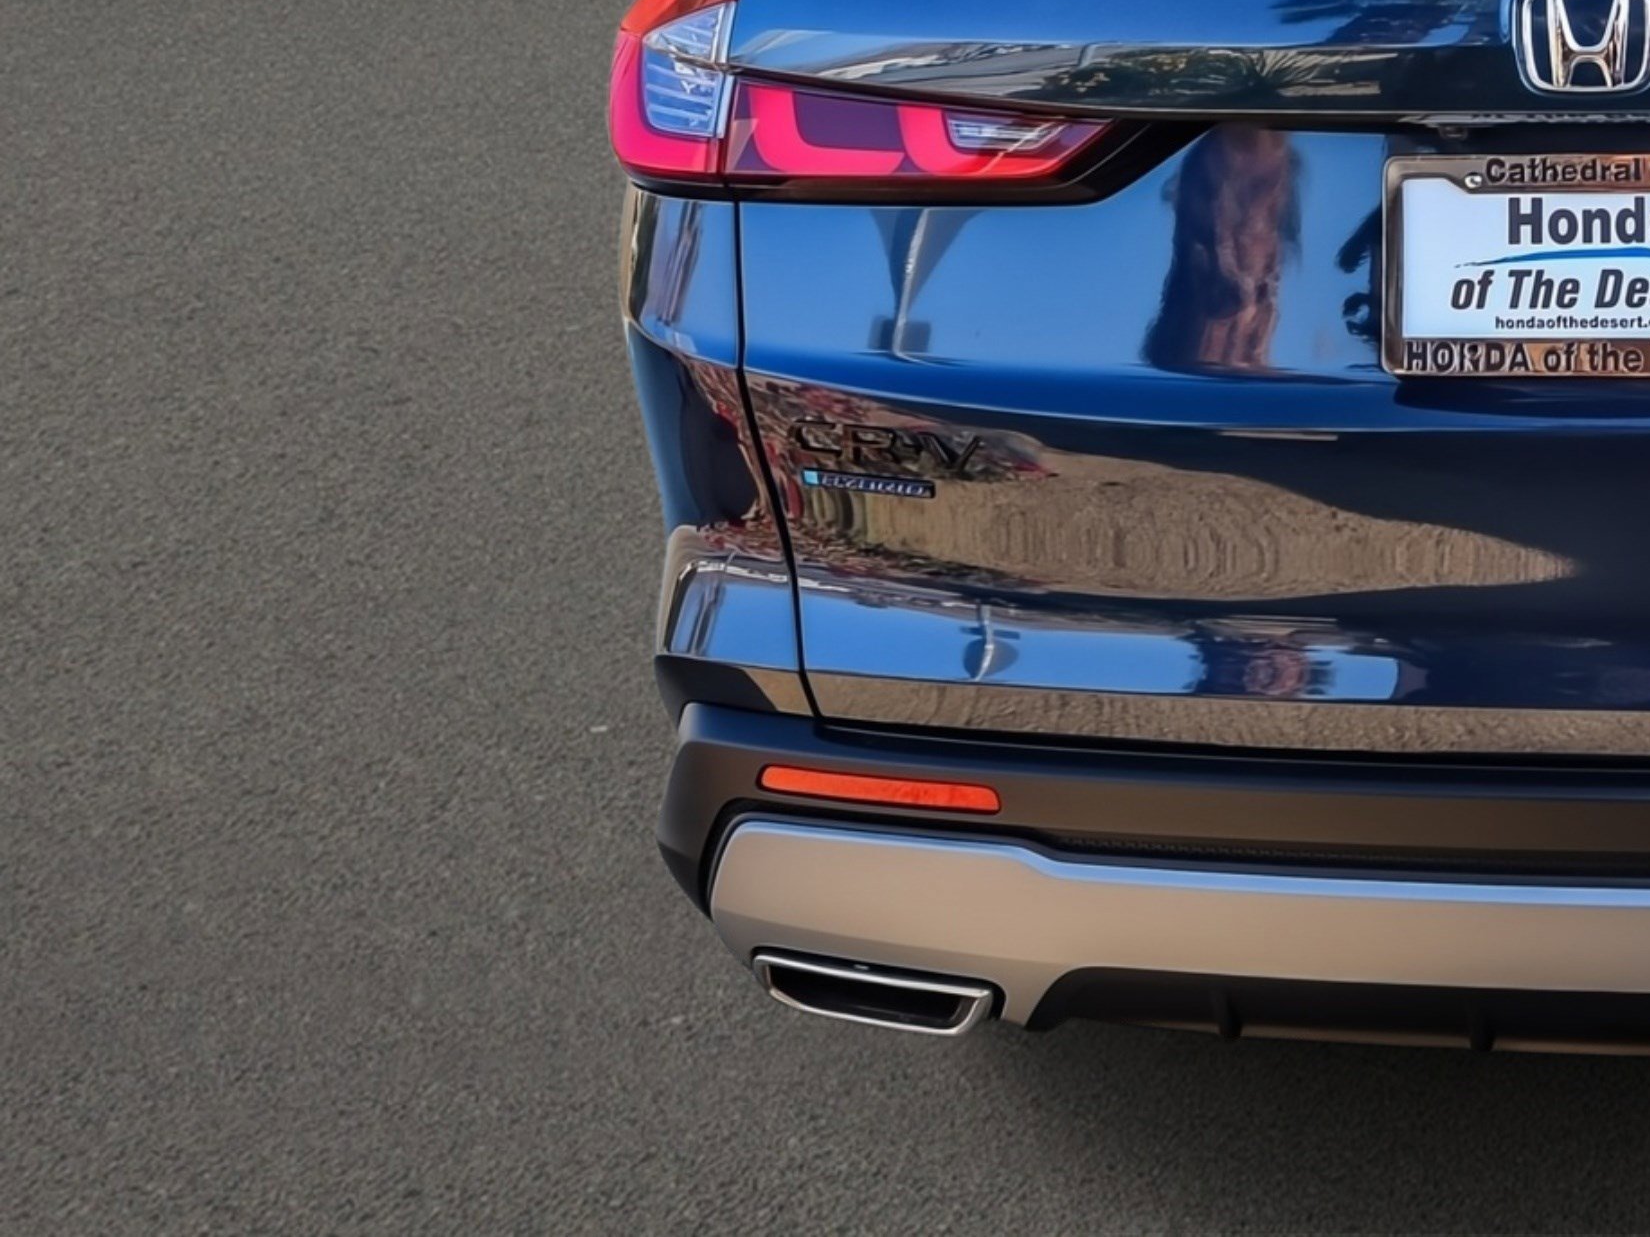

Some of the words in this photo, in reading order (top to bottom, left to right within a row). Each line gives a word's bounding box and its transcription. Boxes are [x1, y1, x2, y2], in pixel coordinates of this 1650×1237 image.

[1485, 157, 1642, 186] Cathedral
[1450, 268, 1495, 311] of
[1507, 268, 1581, 311] The
[1405, 340, 1532, 373] HONDA
[1542, 342, 1577, 373] of
[1587, 341, 1644, 373] the
